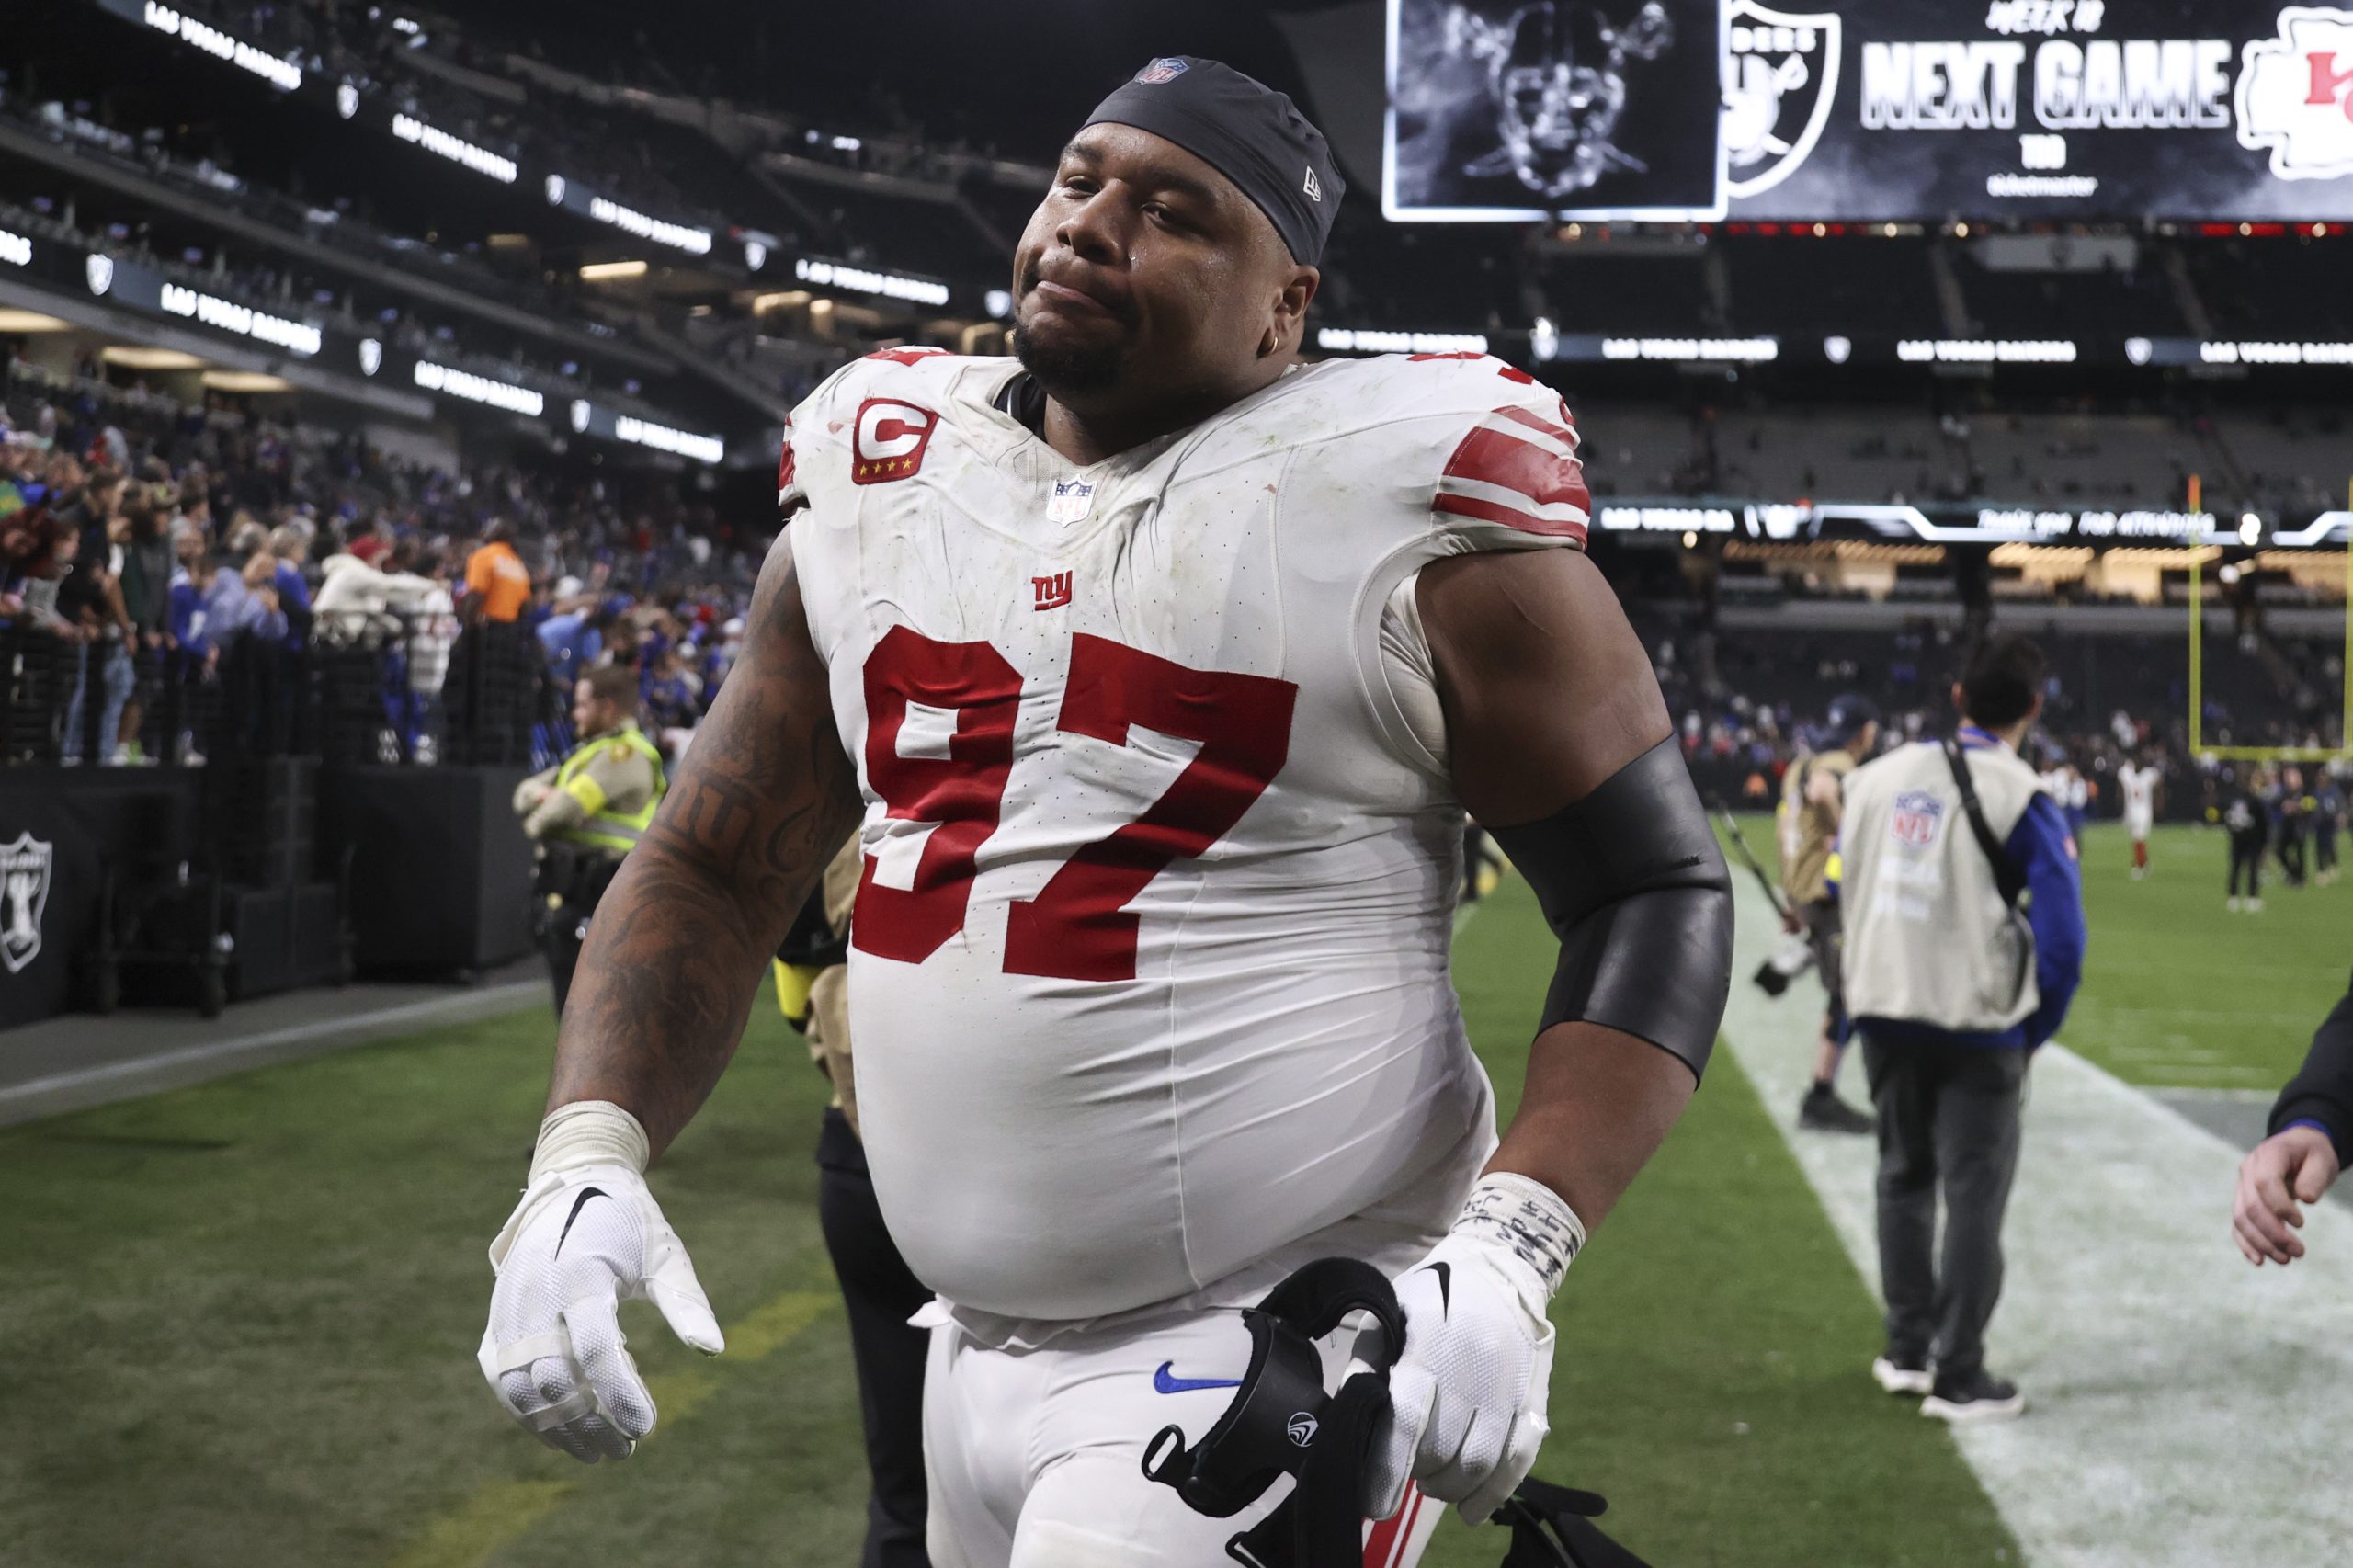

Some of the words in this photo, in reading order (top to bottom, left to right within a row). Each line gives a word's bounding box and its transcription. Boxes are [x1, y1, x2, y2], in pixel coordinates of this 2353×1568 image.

[1860, 41, 2025, 129] NEXT
[2034, 40, 2232, 129] GAME
[858, 403, 928, 460] C
[851, 624, 1299, 981] 97
